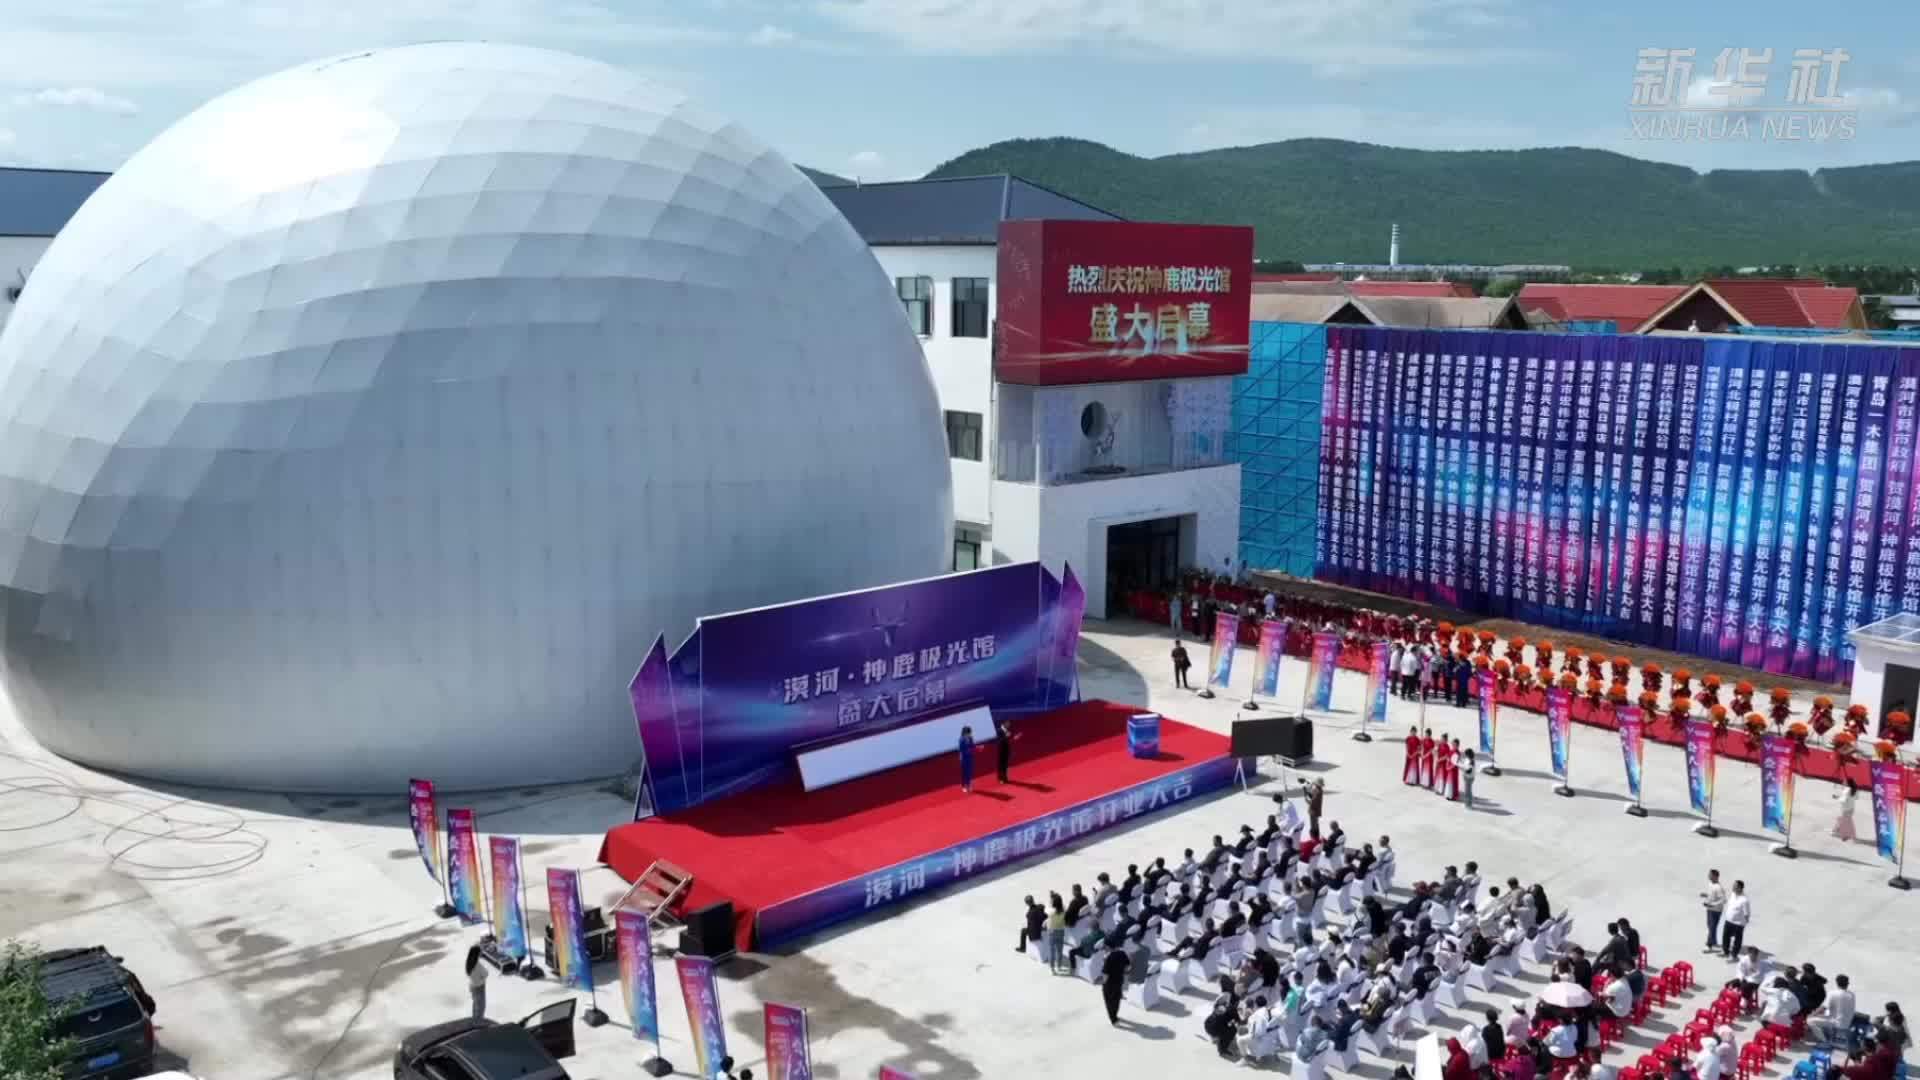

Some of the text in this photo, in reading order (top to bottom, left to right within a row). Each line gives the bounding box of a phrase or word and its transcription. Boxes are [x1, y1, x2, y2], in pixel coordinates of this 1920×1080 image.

[1068, 265, 1231, 294] 热烈庆祝神鹿极光馆
[1089, 302, 1212, 343] 盛大启幕
[1862, 376, 1888, 471] 青岛一木集团
[784, 635, 996, 704] 漠河·神鹿极光馆
[838, 679, 946, 727] 盛大启幕
[864, 773, 1193, 908] 漠河·神鹿极光馆开业大吉
